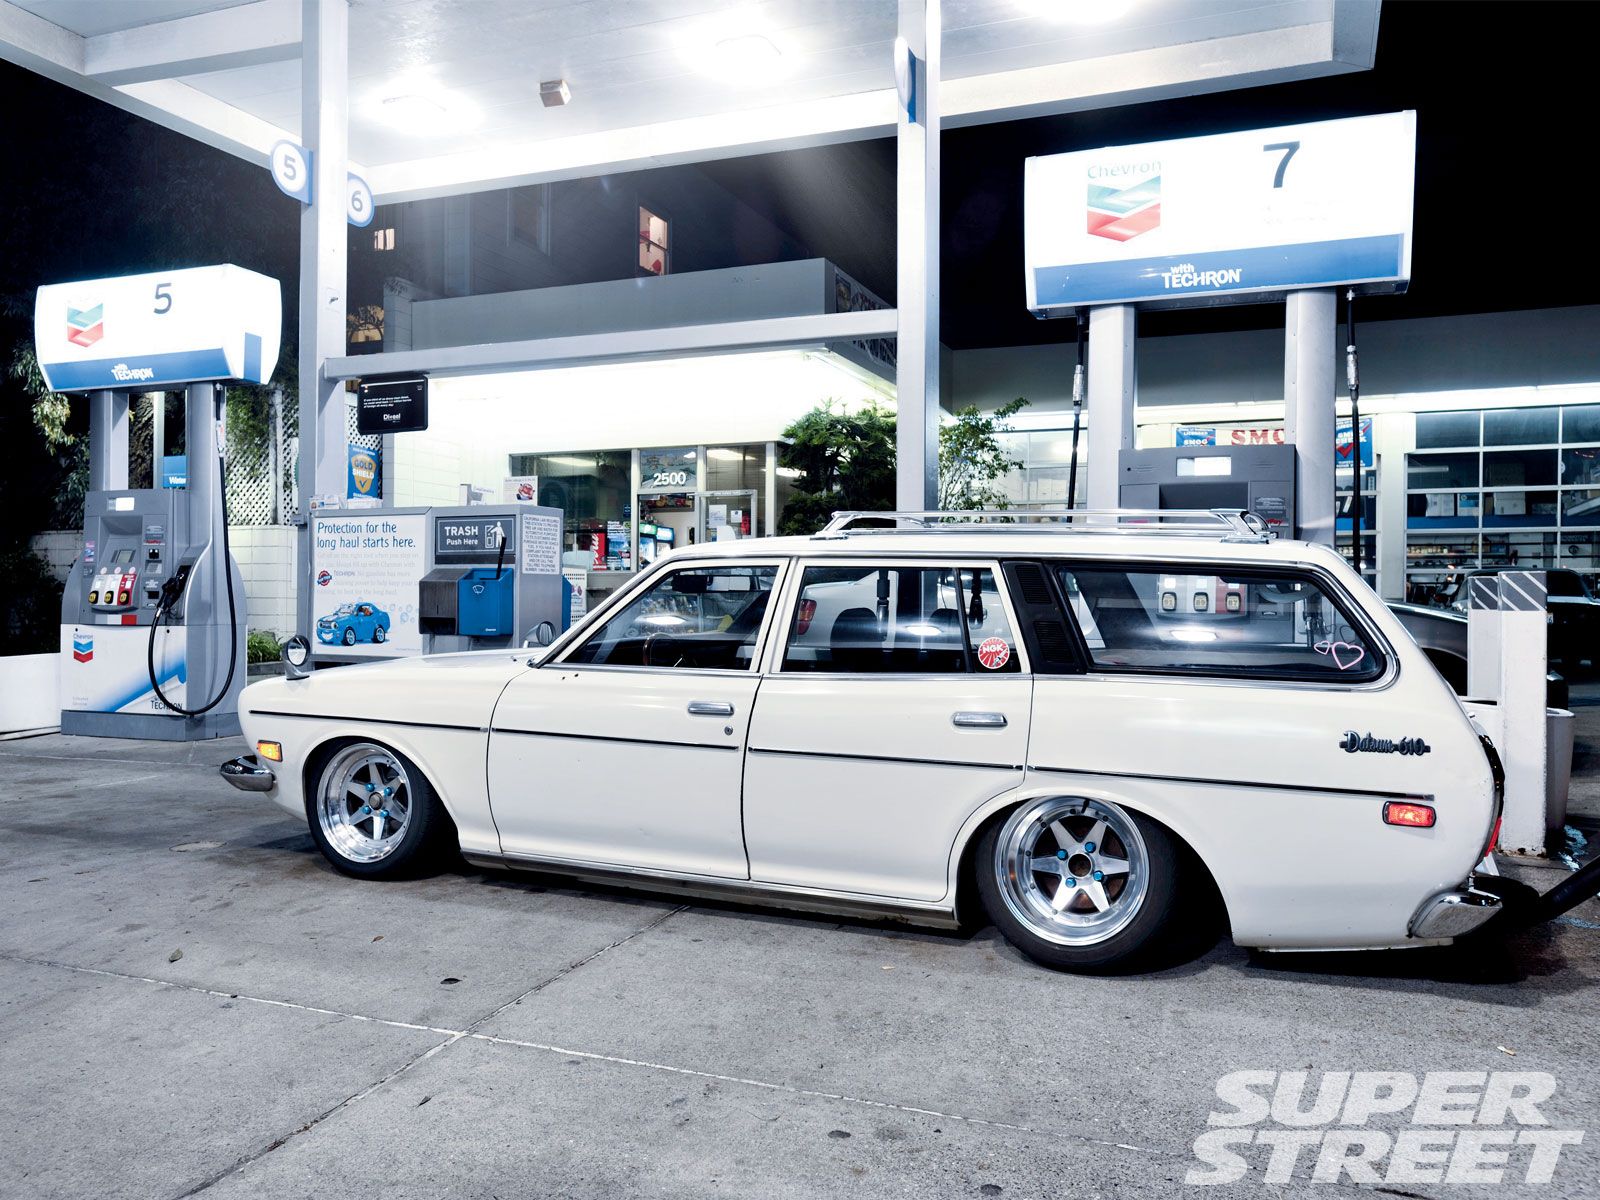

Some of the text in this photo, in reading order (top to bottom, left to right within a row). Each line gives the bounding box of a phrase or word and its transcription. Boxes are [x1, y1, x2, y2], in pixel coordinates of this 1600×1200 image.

[283, 154, 297, 181] 5
[1087, 160, 1162, 179] Chevron
[1263, 141, 1300, 189] 7
[351, 190, 363, 213] 6
[1170, 263, 1195, 275] with
[1161, 268, 1242, 289] TECHRON
[153, 282, 172, 315] 5
[111, 367, 154, 381] TECHRON
[653, 471, 687, 486] 2500
[317, 521, 397, 534] Protection for the
[444, 525, 479, 536] TRASH
[317, 535, 416, 551] long haul starts here.
[983, 643, 1004, 653] NGK
[1342, 730, 1425, 756] Datsun 610
